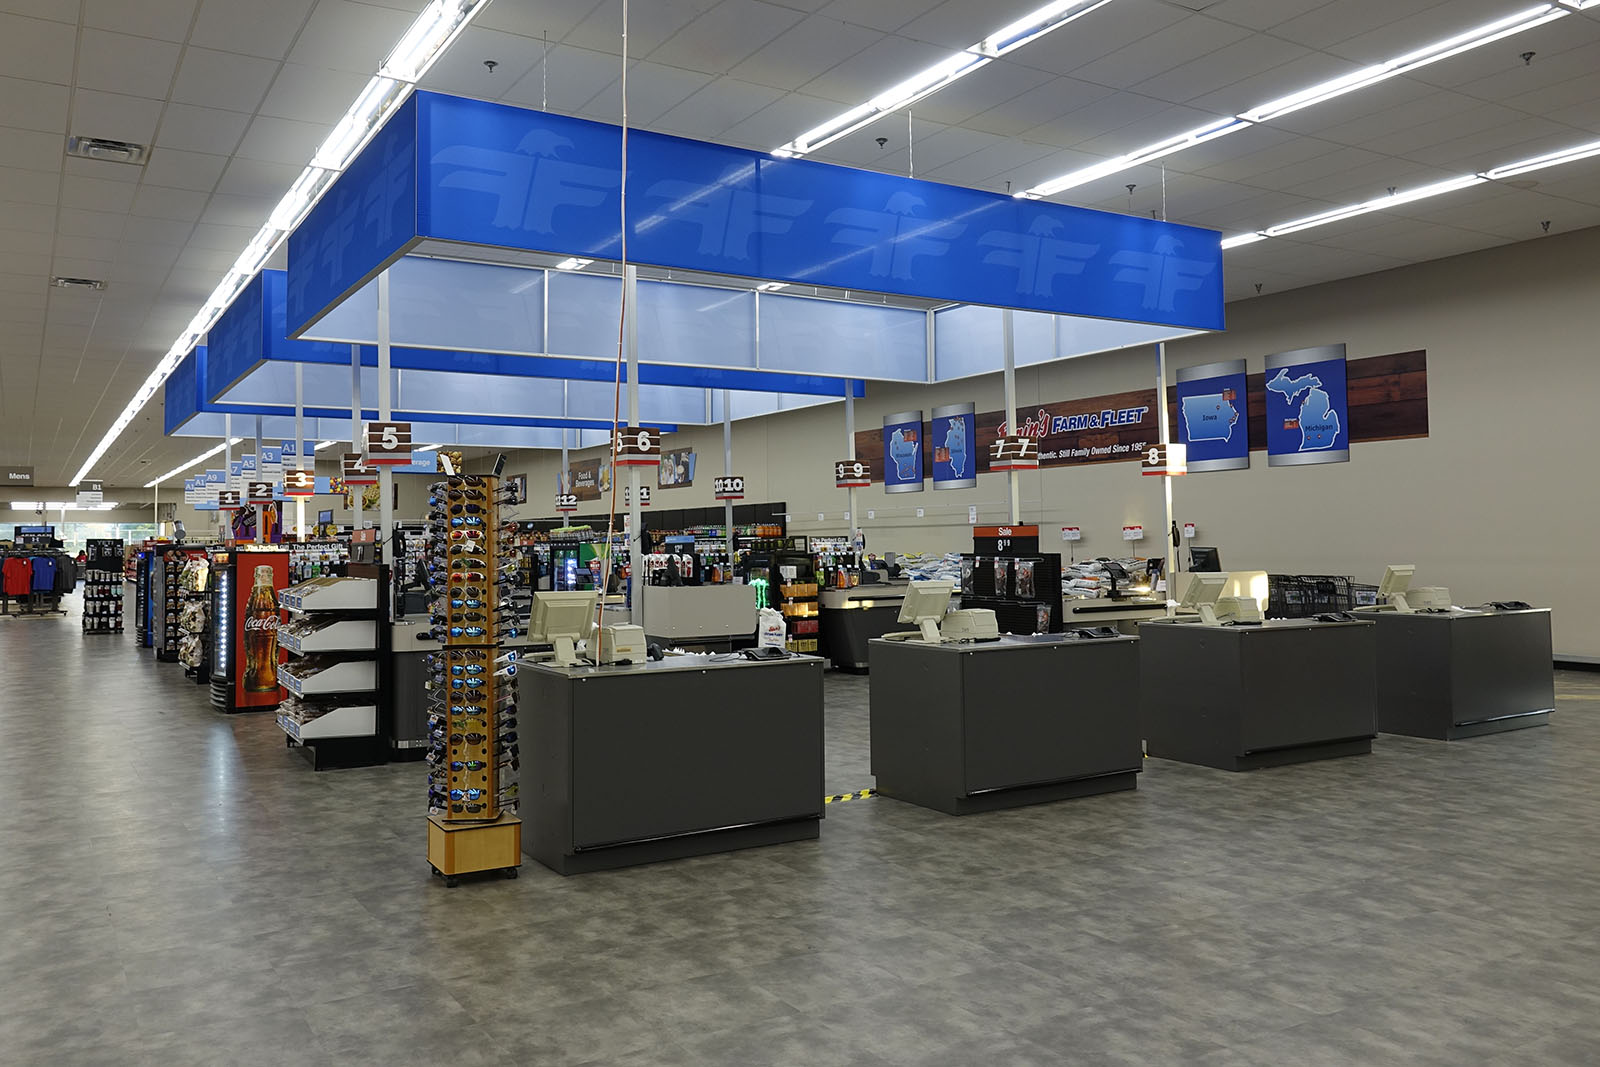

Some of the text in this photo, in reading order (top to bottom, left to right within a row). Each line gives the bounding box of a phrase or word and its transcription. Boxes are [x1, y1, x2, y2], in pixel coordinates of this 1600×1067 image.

[1051, 414, 1088, 434] FARM
[1088, 412, 1099, 429] &
[1100, 406, 1148, 428] FLEET
[1305, 424, 1334, 433] Michigan
[382, 426, 398, 450] 5
[638, 431, 650, 452] 6
[996, 439, 1005, 458] 7
[1018, 438, 1030, 456] 7
[1058, 450, 1070, 458] Still
[1071, 448, 1090, 458] Family
[1092, 446, 1112, 456] Owned
[1113, 444, 1129, 454] Since
[262, 452, 273, 460] A3
[1148, 448, 1158, 464] 8
[353, 456, 367, 473] 4
[854, 463, 864, 477] 9
[295, 472, 306, 487] 3
[724, 478, 742, 491] 10
[256, 484, 267, 496] 2
[224, 492, 234, 504] 1
[562, 494, 577, 505] 12
[998, 528, 1012, 536] Sale
[245, 615, 282, 632] Coca-Col
